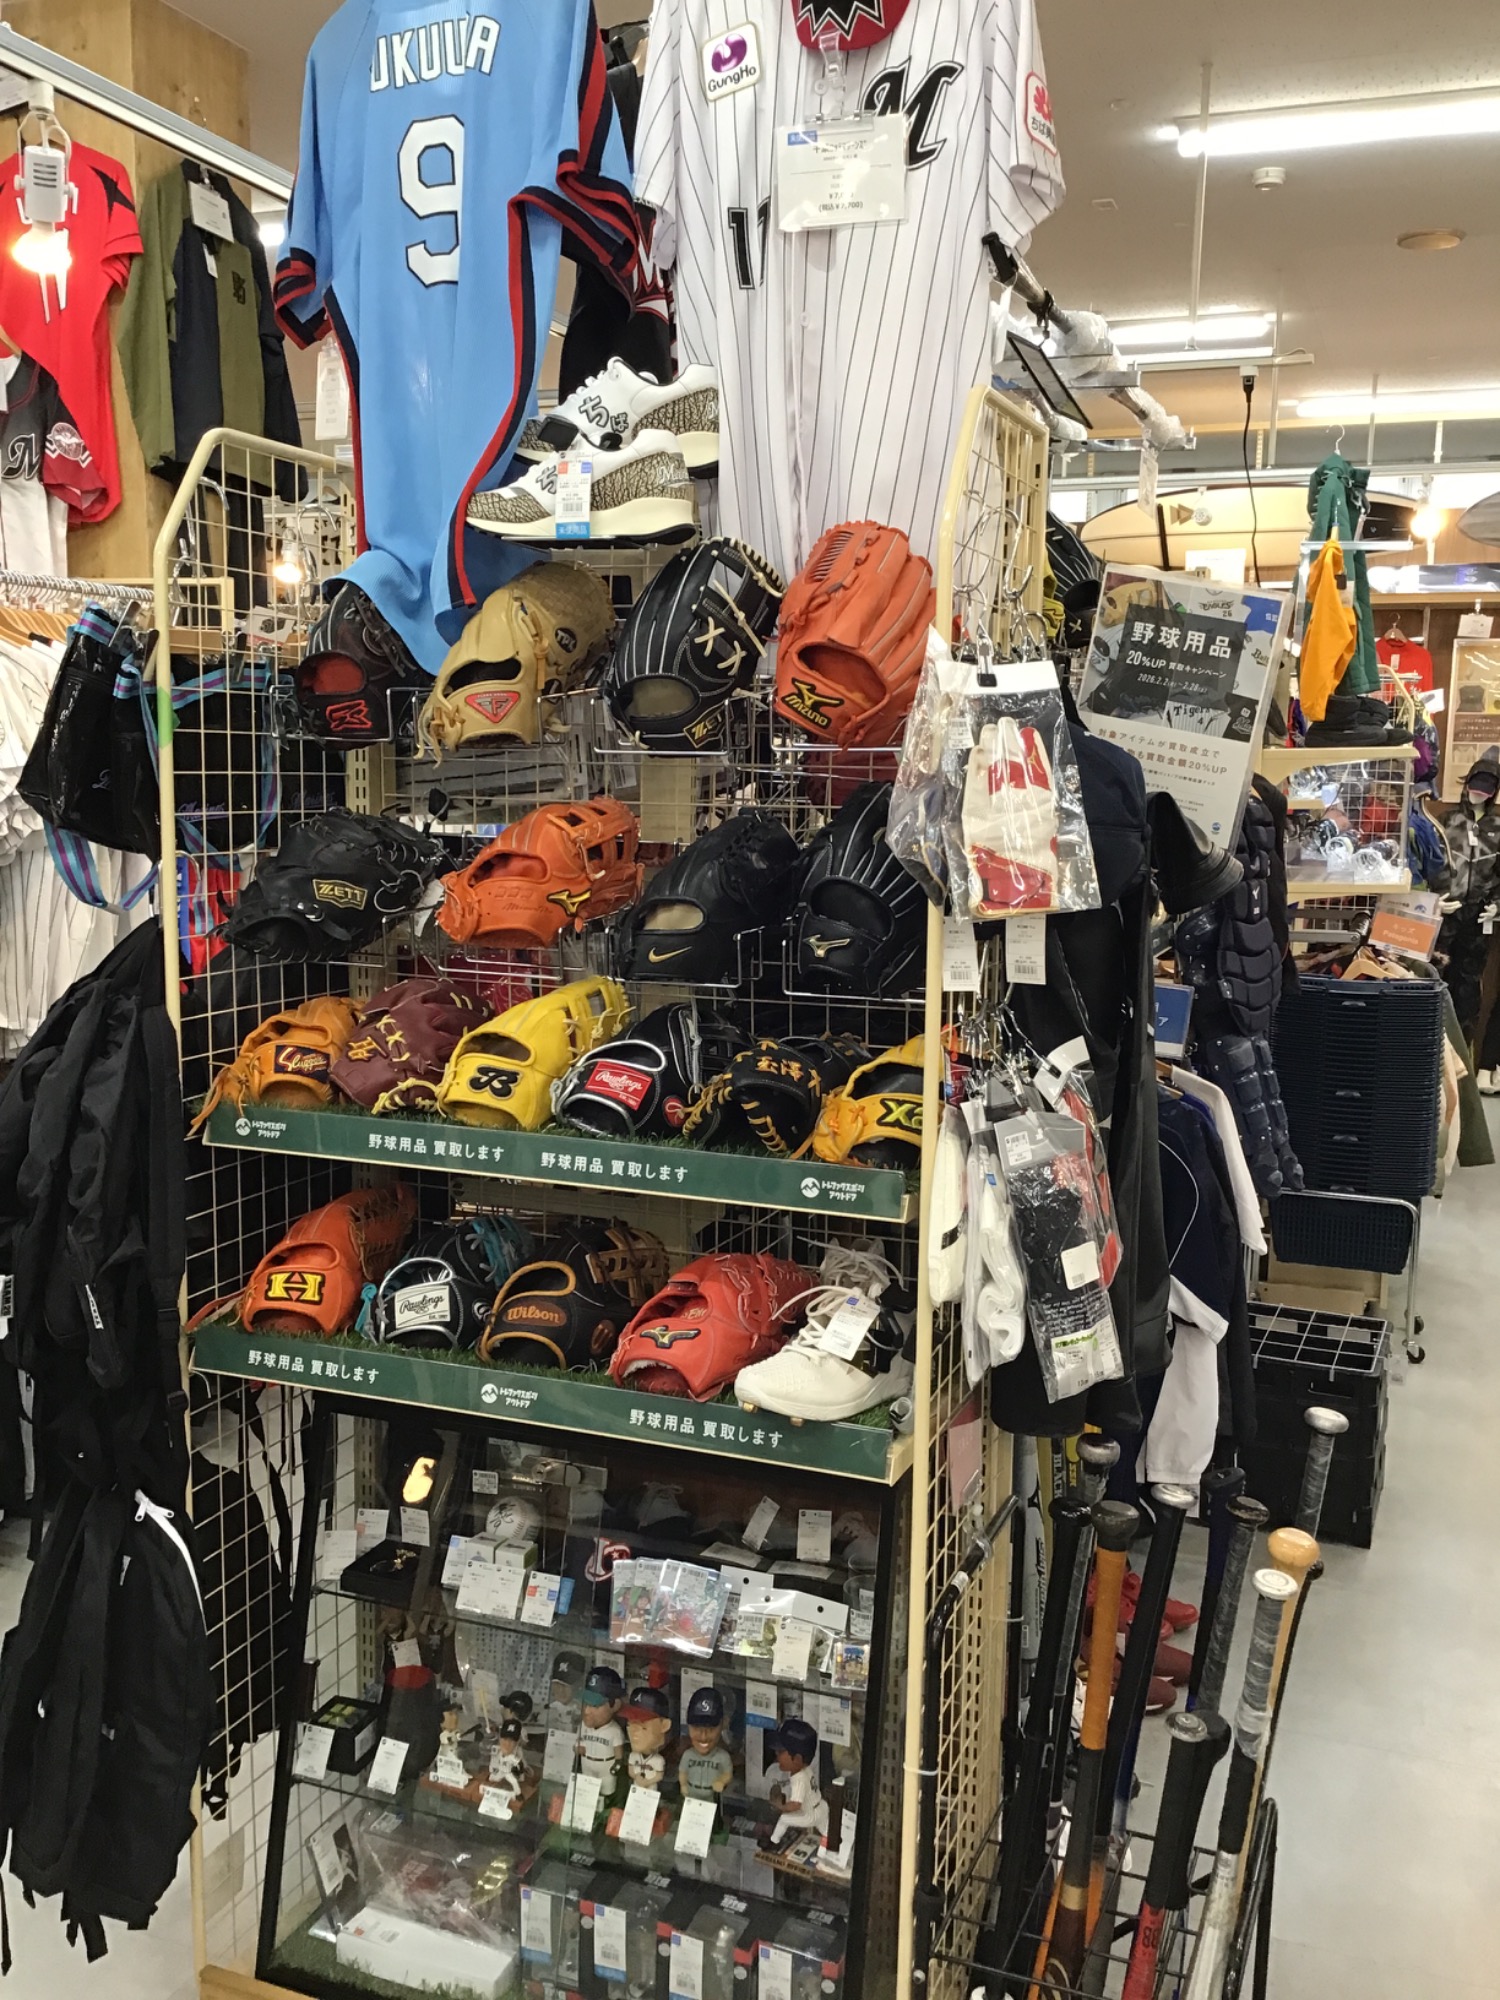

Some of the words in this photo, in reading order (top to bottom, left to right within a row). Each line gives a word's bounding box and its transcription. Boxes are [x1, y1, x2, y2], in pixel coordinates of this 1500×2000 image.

[707, 65, 757, 93] GungHo
[397, 113, 465, 289] 9
[578, 394, 630, 434] ちば
[1131, 621, 1231, 659] 野球用品
[1126, 650, 1167, 668] 20%UP
[1168, 662, 1227, 678] 買取キャンペーン
[595, 1070, 643, 1093] Rawlings
[257, 1129, 281, 1139] アウトドア
[368, 1133, 427, 1154] 野球用品
[433, 1140, 504, 1163] 買取します
[540, 1152, 604, 1174] 野球用品
[611, 1159, 688, 1182] 買取します
[829, 1190, 858, 1202] アウトドア
[399, 1294, 445, 1316] Rawlings
[508, 1306, 561, 1323] Wilson
[248, 1350, 305, 1372] 野球用品
[311, 1360, 380, 1384] 買取します
[505, 1397, 531, 1409] アウトドア
[629, 1408, 696, 1434] 野球用品
[703, 1421, 783, 1449] 買取します
[1053, 1452, 1063, 1498] BLACK
[1068, 1462, 1077, 1488] SSK
